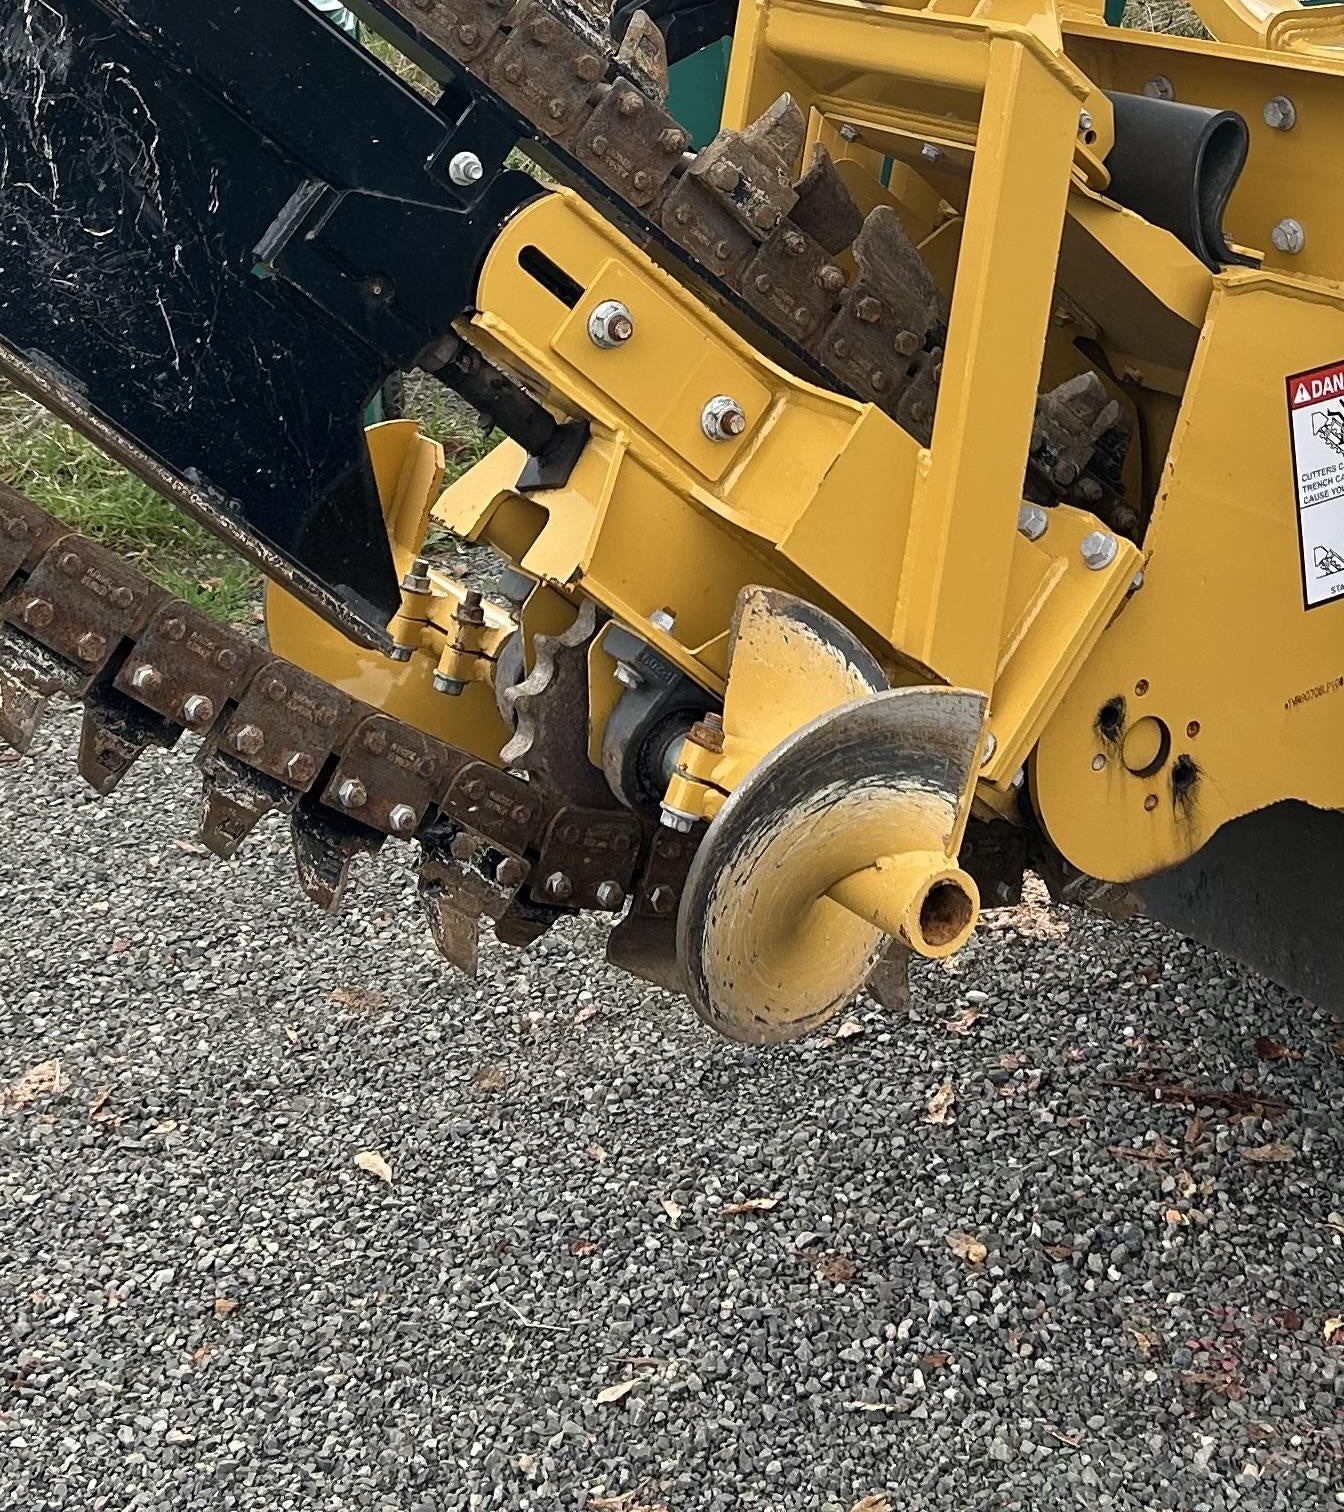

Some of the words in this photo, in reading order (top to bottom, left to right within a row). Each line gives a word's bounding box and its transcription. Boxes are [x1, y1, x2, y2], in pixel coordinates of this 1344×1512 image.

[1301, 464, 1337, 482] CUTTERS
[1302, 476, 1334, 494] TRENCH
[1303, 488, 1330, 506] CAUSE
